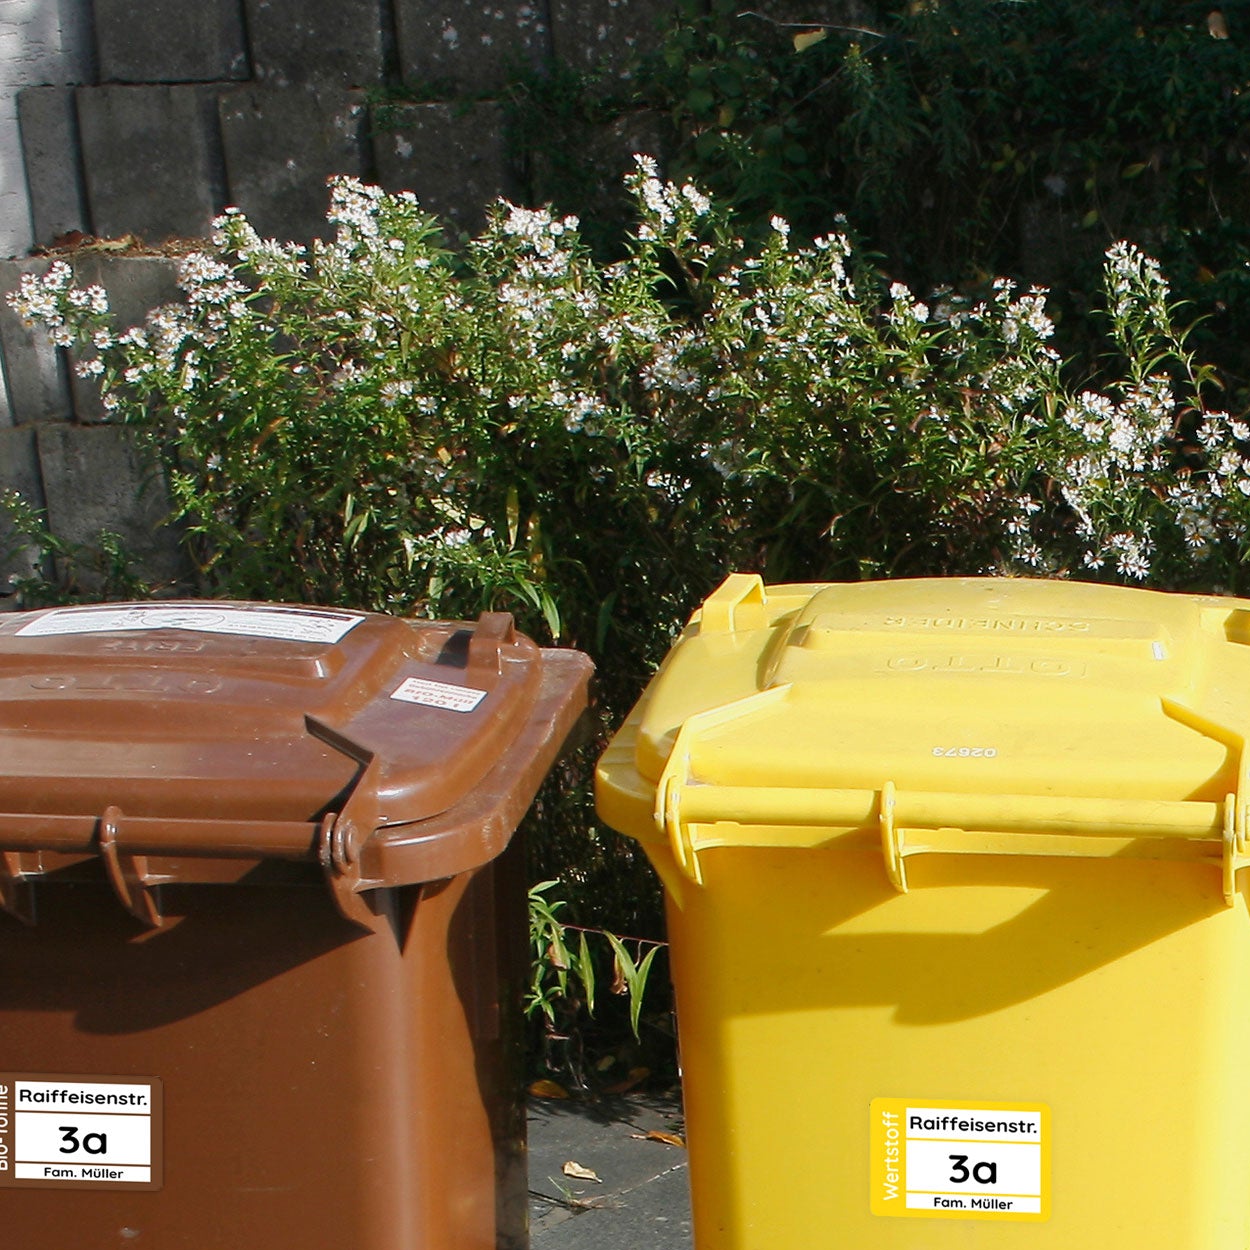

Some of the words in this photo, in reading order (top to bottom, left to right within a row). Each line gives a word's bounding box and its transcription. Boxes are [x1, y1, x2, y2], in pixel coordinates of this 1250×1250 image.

[884, 616, 1091, 632] SCHNEIDER
[886, 655, 1071, 676] OTTO
[29, 674, 224, 694] OTTO
[932, 746, 998, 757] 02673
[19, 1089, 148, 1106] Raiffeisenstr.
[910, 1116, 1038, 1133] Raiffeisenstr.
[58, 1126, 107, 1155] 3a
[881, 1111, 899, 1200] Wertstoff
[44, 1167, 77, 1178] Fam.
[81, 1168, 124, 1179] Müller
[948, 1154, 997, 1184] 3a
[933, 1197, 967, 1208] Fam.
[971, 1198, 1013, 1210] Müller
